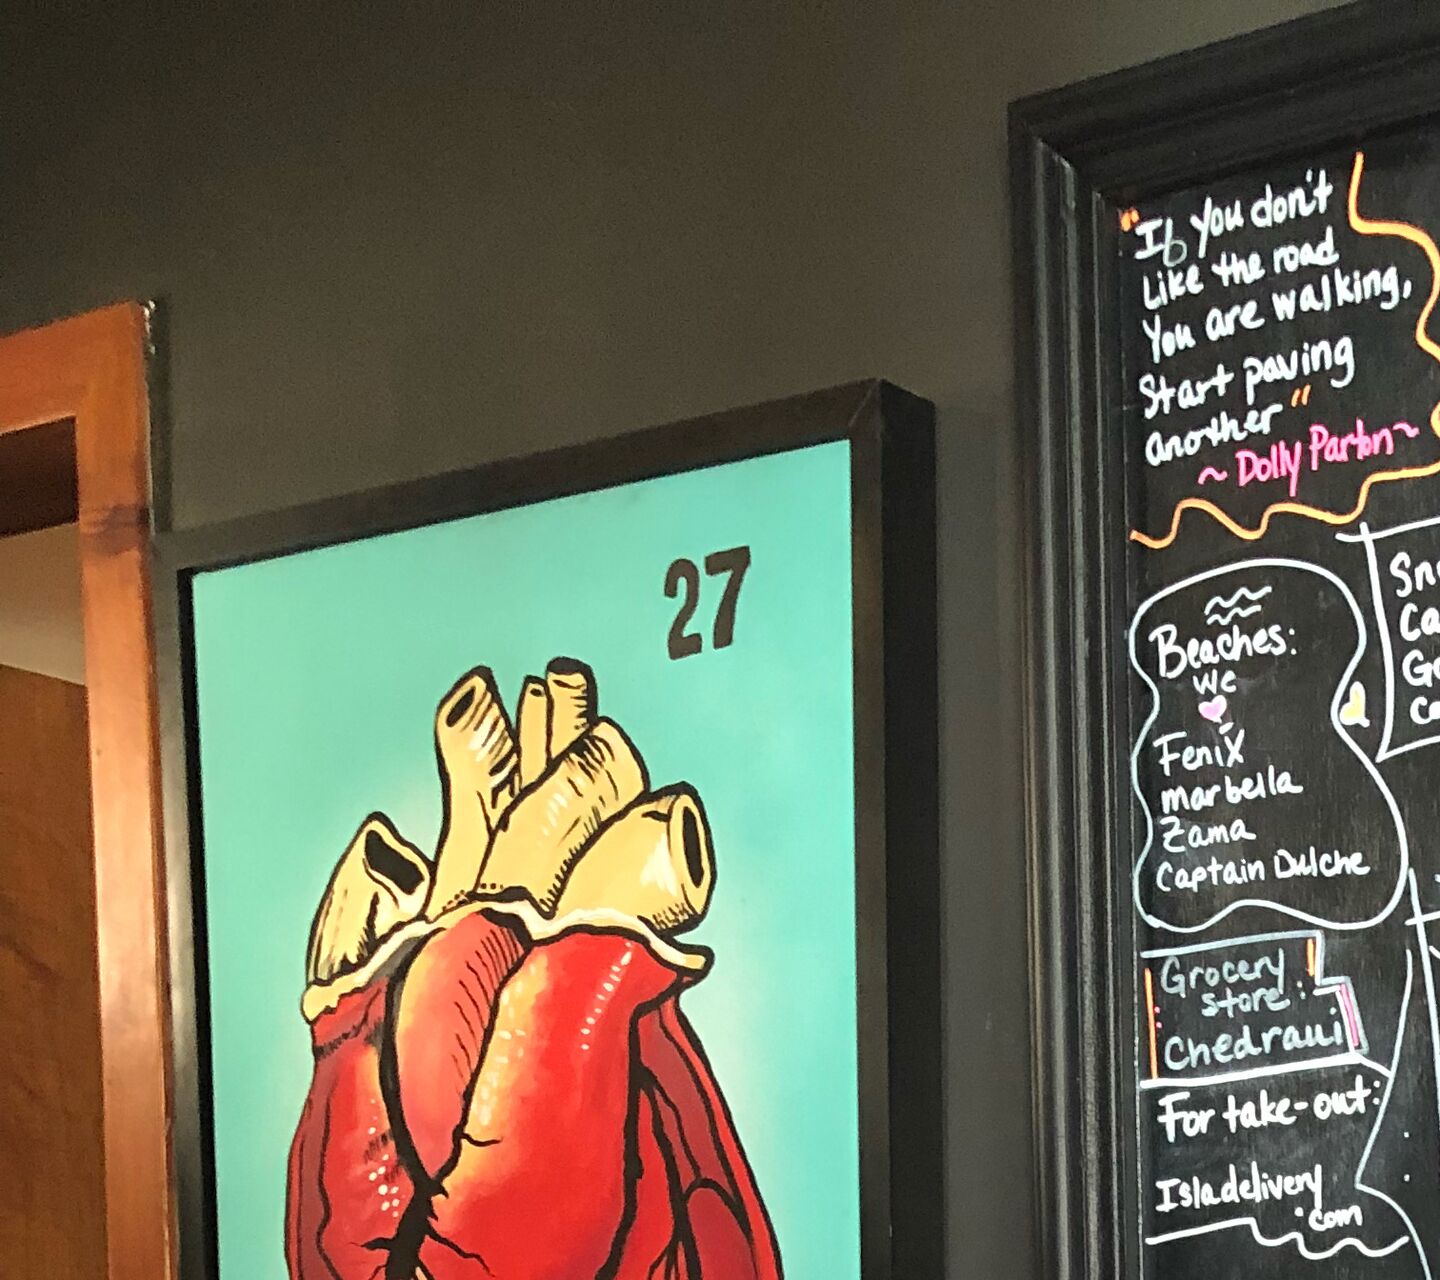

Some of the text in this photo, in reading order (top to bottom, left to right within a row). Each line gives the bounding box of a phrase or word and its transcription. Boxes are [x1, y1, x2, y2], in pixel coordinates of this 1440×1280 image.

[1251, 170, 1334, 226] don't
[1213, 252, 1267, 288] the
[1273, 227, 1340, 272] road
[1143, 265, 1412, 363] You are walking,
[1139, 334, 1355, 419] Start paving
[1236, 420, 1395, 496] Dolly Parton
[664, 545, 751, 661] 27
[1149, 623, 1297, 678] Beaches:
[1159, 816, 1257, 853] Zama
[1155, 846, 1371, 892] Captain Dulche
[1160, 948, 1285, 998] Grocery
[1164, 1006, 1344, 1071] Chedraui
[1157, 1091, 1216, 1143] For
